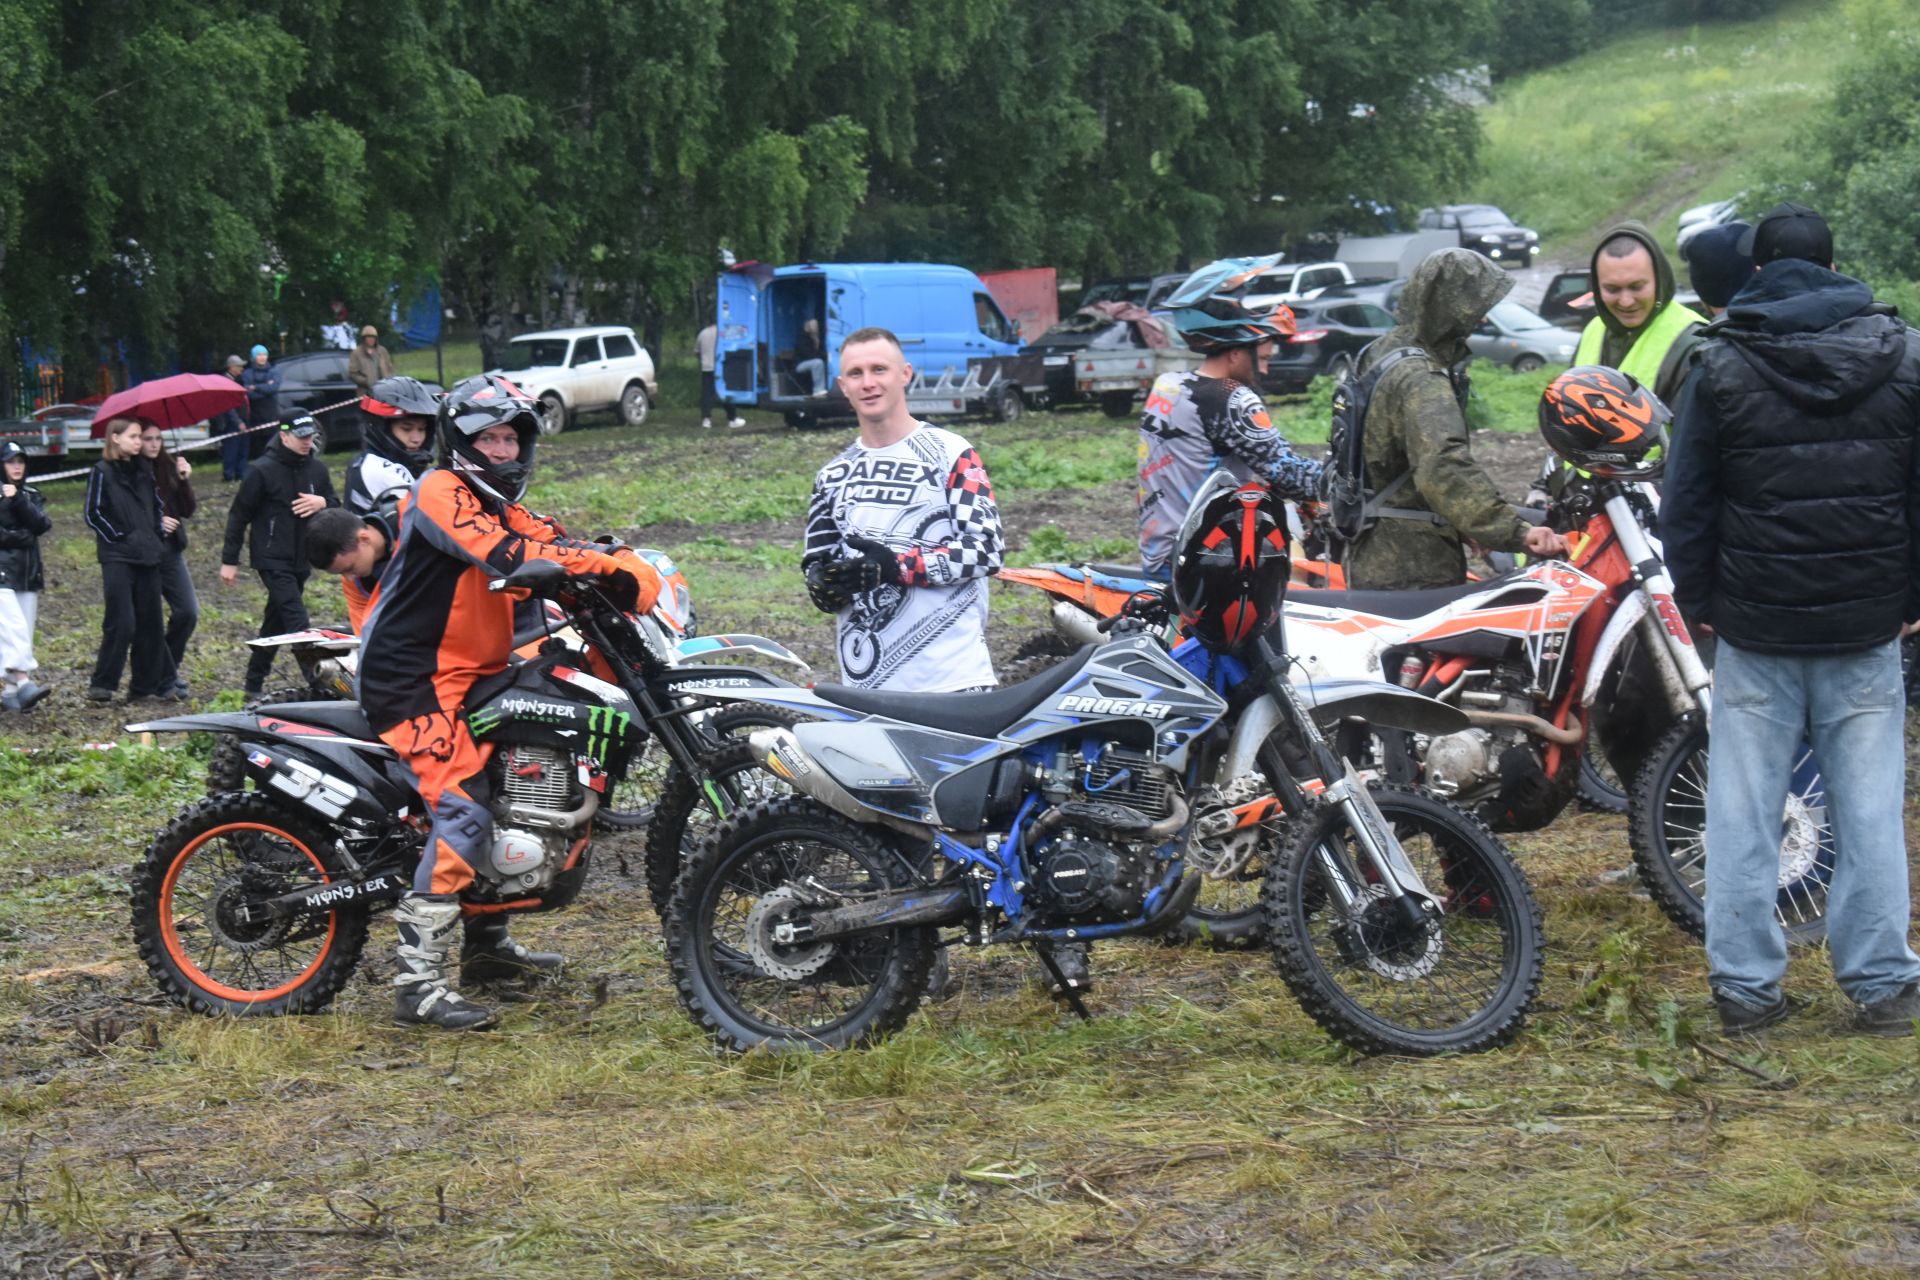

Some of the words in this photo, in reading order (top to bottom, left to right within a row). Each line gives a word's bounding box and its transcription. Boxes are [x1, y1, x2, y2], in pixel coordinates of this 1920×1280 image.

[826, 460, 940, 488] DAREX
[843, 483, 914, 501] MOTO
[668, 678, 751, 692] MONSTER
[501, 698, 576, 719] MONSTER
[1056, 695, 1172, 719] PROGASI
[514, 713, 561, 724] ENERGY
[306, 877, 389, 907] MONSTER
